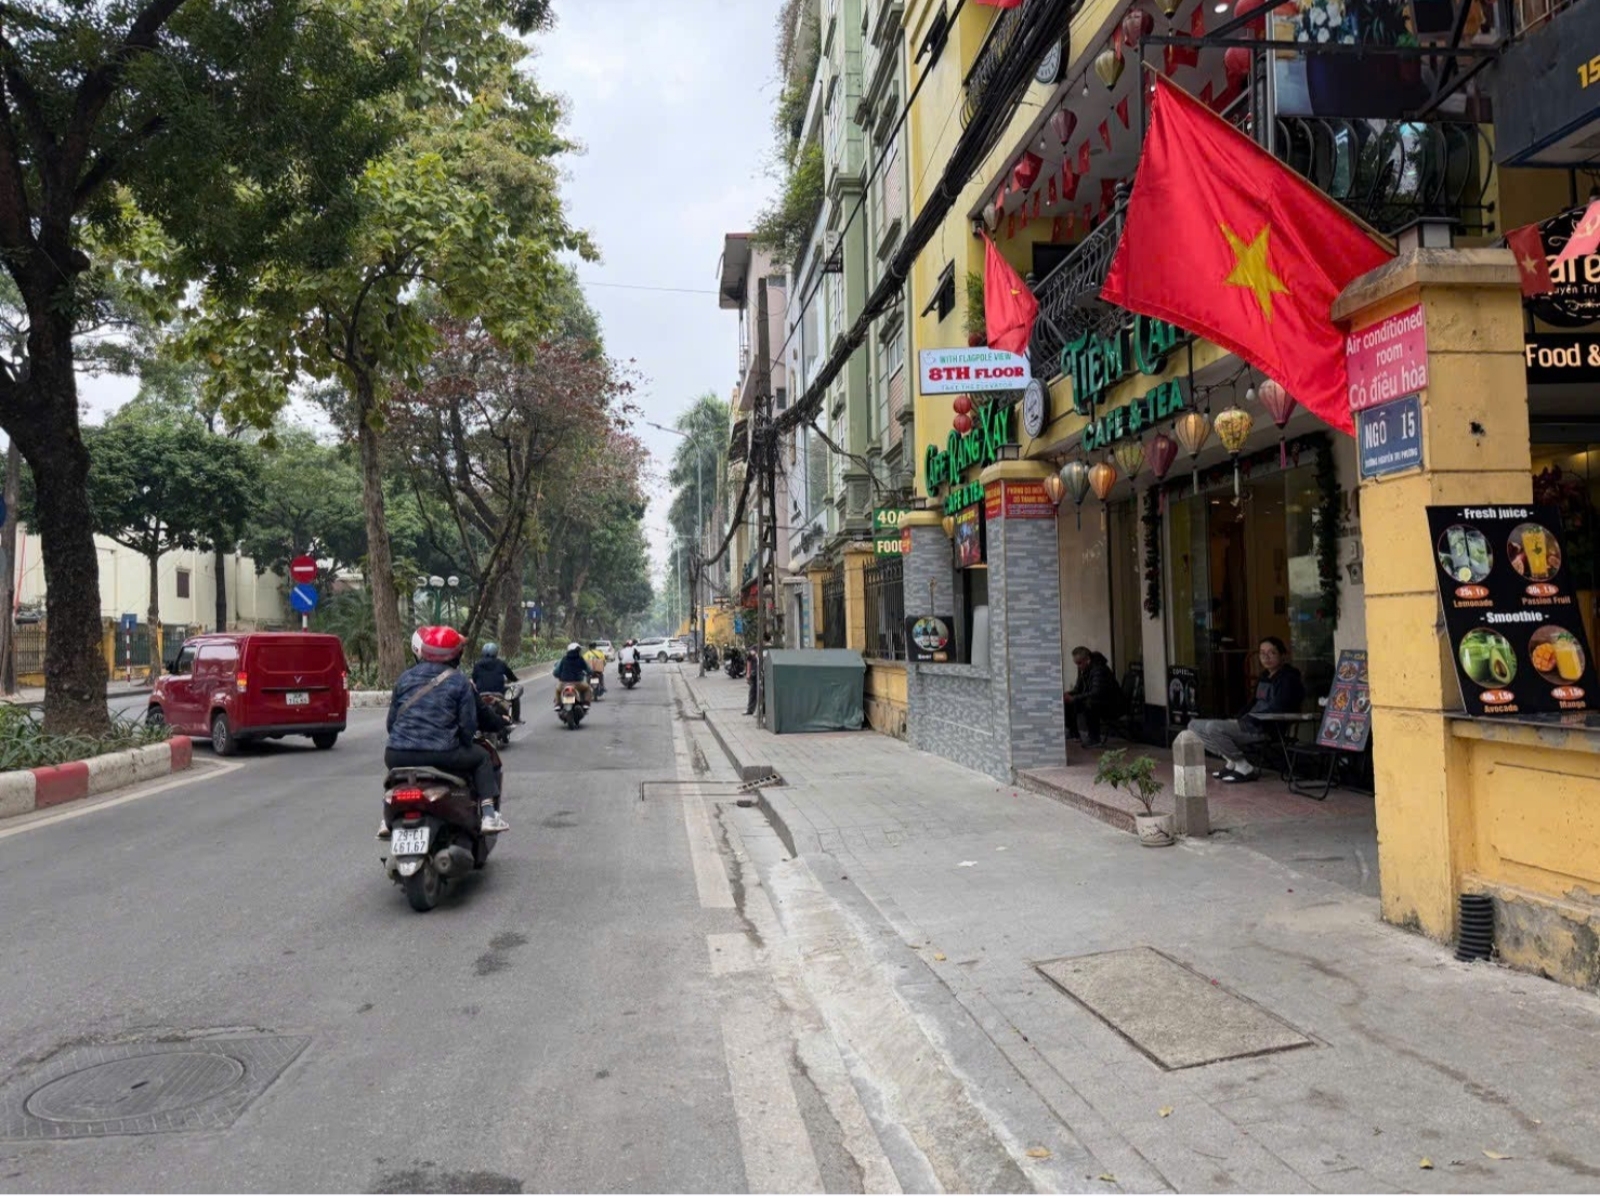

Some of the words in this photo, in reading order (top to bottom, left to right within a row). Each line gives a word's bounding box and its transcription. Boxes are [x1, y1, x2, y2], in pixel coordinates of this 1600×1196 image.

[1346, 334, 1361, 356] Air
[1362, 305, 1423, 349] conditioned
[940, 355, 958, 364] WITH
[959, 353, 992, 363] FLAGPOLE
[993, 352, 1012, 361] VIEW
[1376, 343, 1403, 367] room
[1525, 342, 1581, 367] Food
[1587, 344, 1600, 367] &
[928, 366, 970, 381] 8TH
[974, 366, 1024, 379] FLOOR
[1349, 378, 1366, 409] Có
[1401, 360, 1426, 393] hòa
[1081, 405, 1123, 452] CAFE
[1128, 398, 1142, 432] &
[1146, 376, 1184, 424] TEA
[1365, 411, 1387, 449] NGÕ
[1401, 411, 1416, 440] 15
[946, 428, 980, 487] RANG
[978, 398, 1009, 463] XAY
[944, 488, 961, 515] CAFE
[1464, 507, 1497, 519] Fresh
[877, 540, 904, 553] FOO
[1453, 599, 1494, 608] Lemonade
[1522, 597, 1552, 605] Passion
[1553, 595, 1571, 604] Fruit
[1486, 610, 1543, 624] Smoothie
[1484, 704, 1519, 713] Avocado
[1559, 700, 1586, 710] Mango
